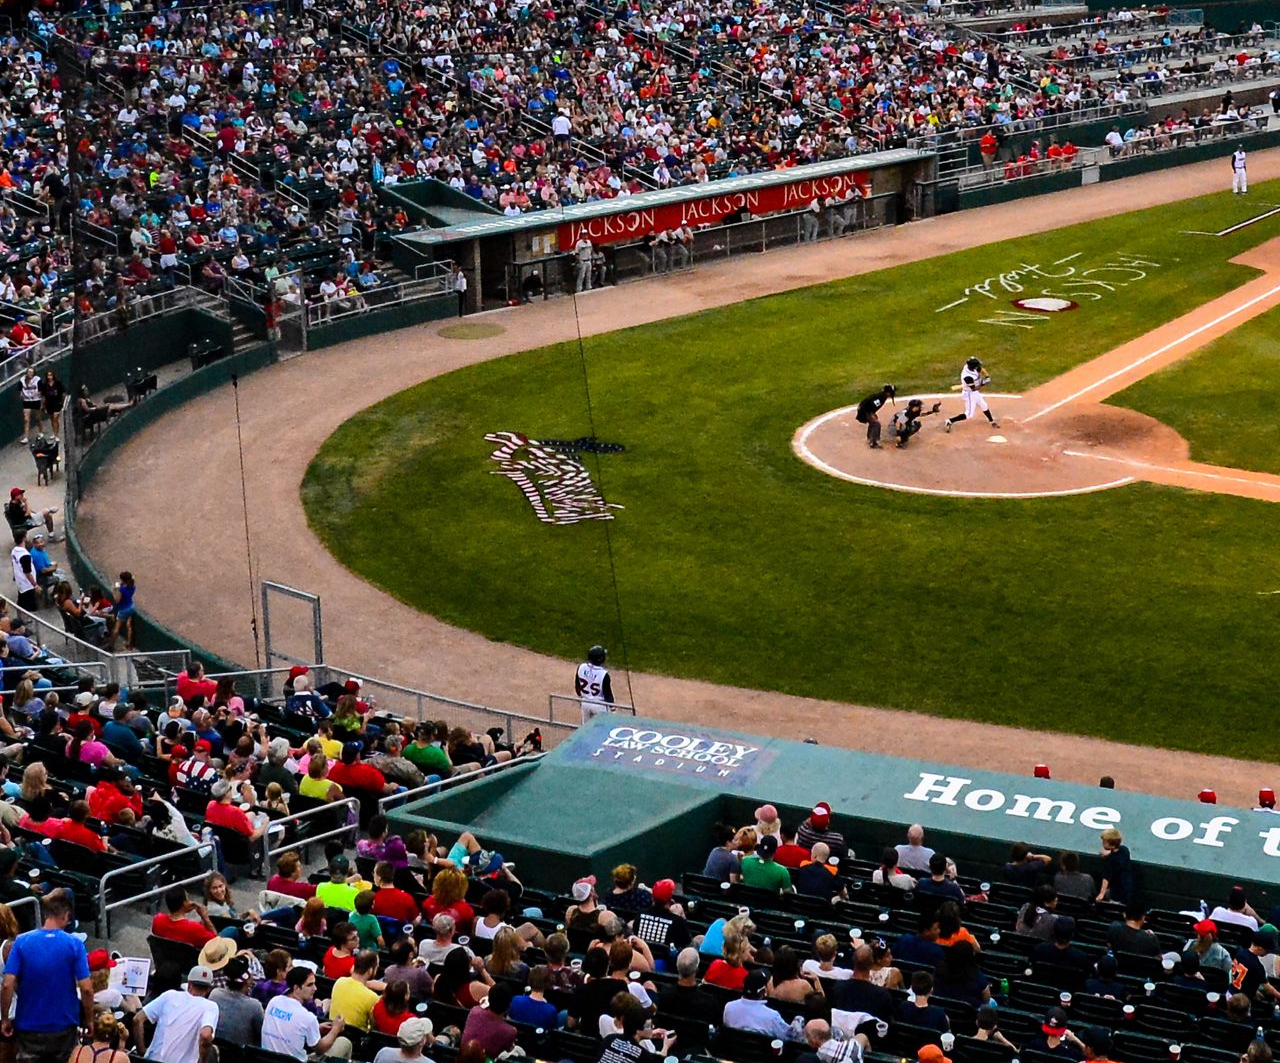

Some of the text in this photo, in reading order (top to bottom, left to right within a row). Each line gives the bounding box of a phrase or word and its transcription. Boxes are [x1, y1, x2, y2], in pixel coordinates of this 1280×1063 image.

[783, 175, 855, 205] JACKSON
[682, 191, 759, 220] JACKSON
[570, 209, 655, 245] JACKSON
[602, 738, 741, 768] LAW SCHOOL
[609, 727, 759, 760] COOLEY
[592, 748, 730, 778] STADIUM
[904, 772, 1121, 830] Home
[1150, 816, 1240, 848] of
